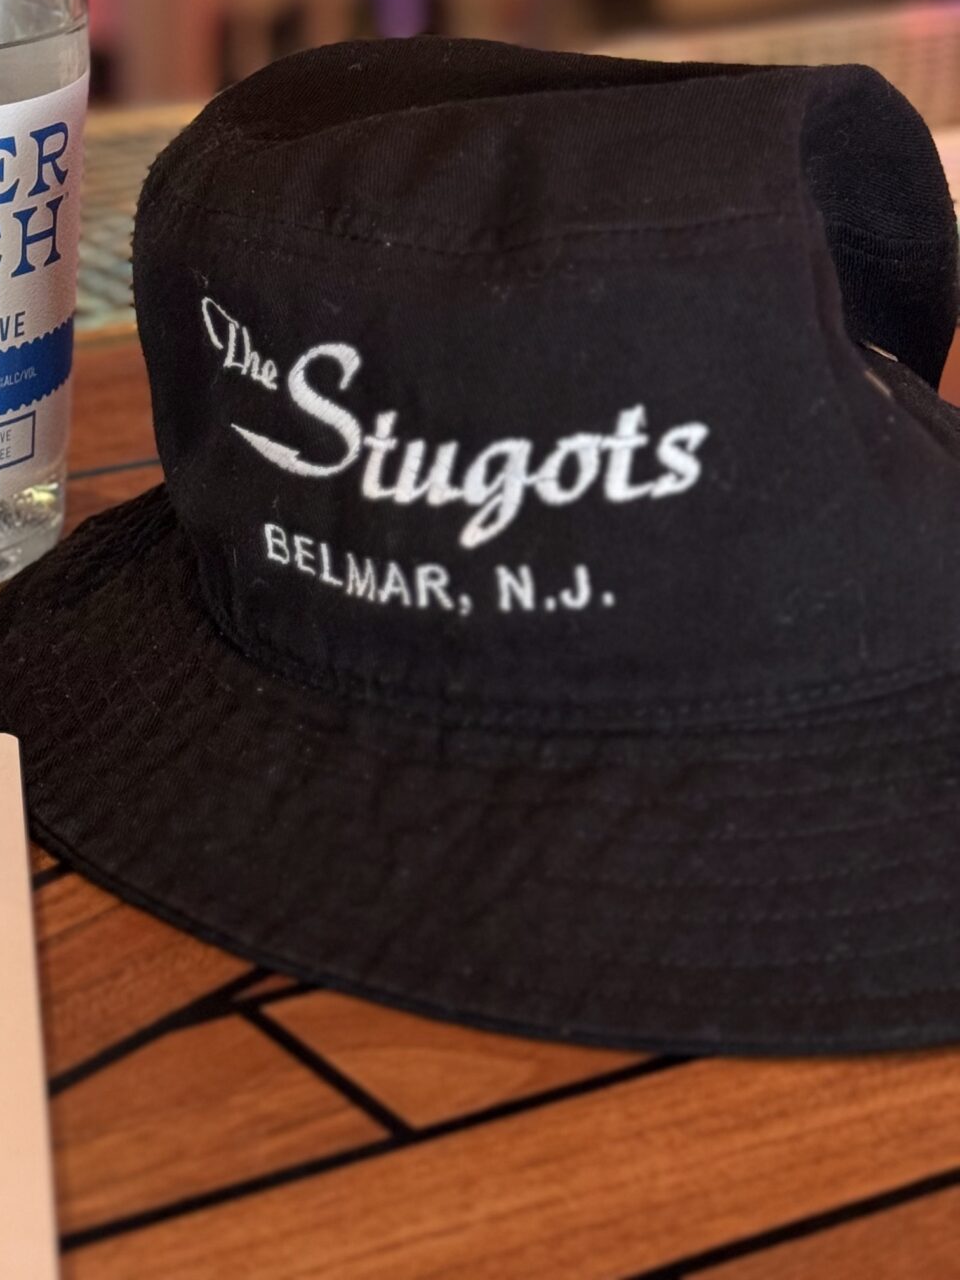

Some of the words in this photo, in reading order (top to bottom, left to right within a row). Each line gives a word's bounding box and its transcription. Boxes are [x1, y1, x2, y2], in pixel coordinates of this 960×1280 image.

[201, 296, 278, 391] The
[230, 342, 709, 549] Stugots
[263, 522, 472, 617] BELMAR,
[496, 564, 615, 612] N.J.
